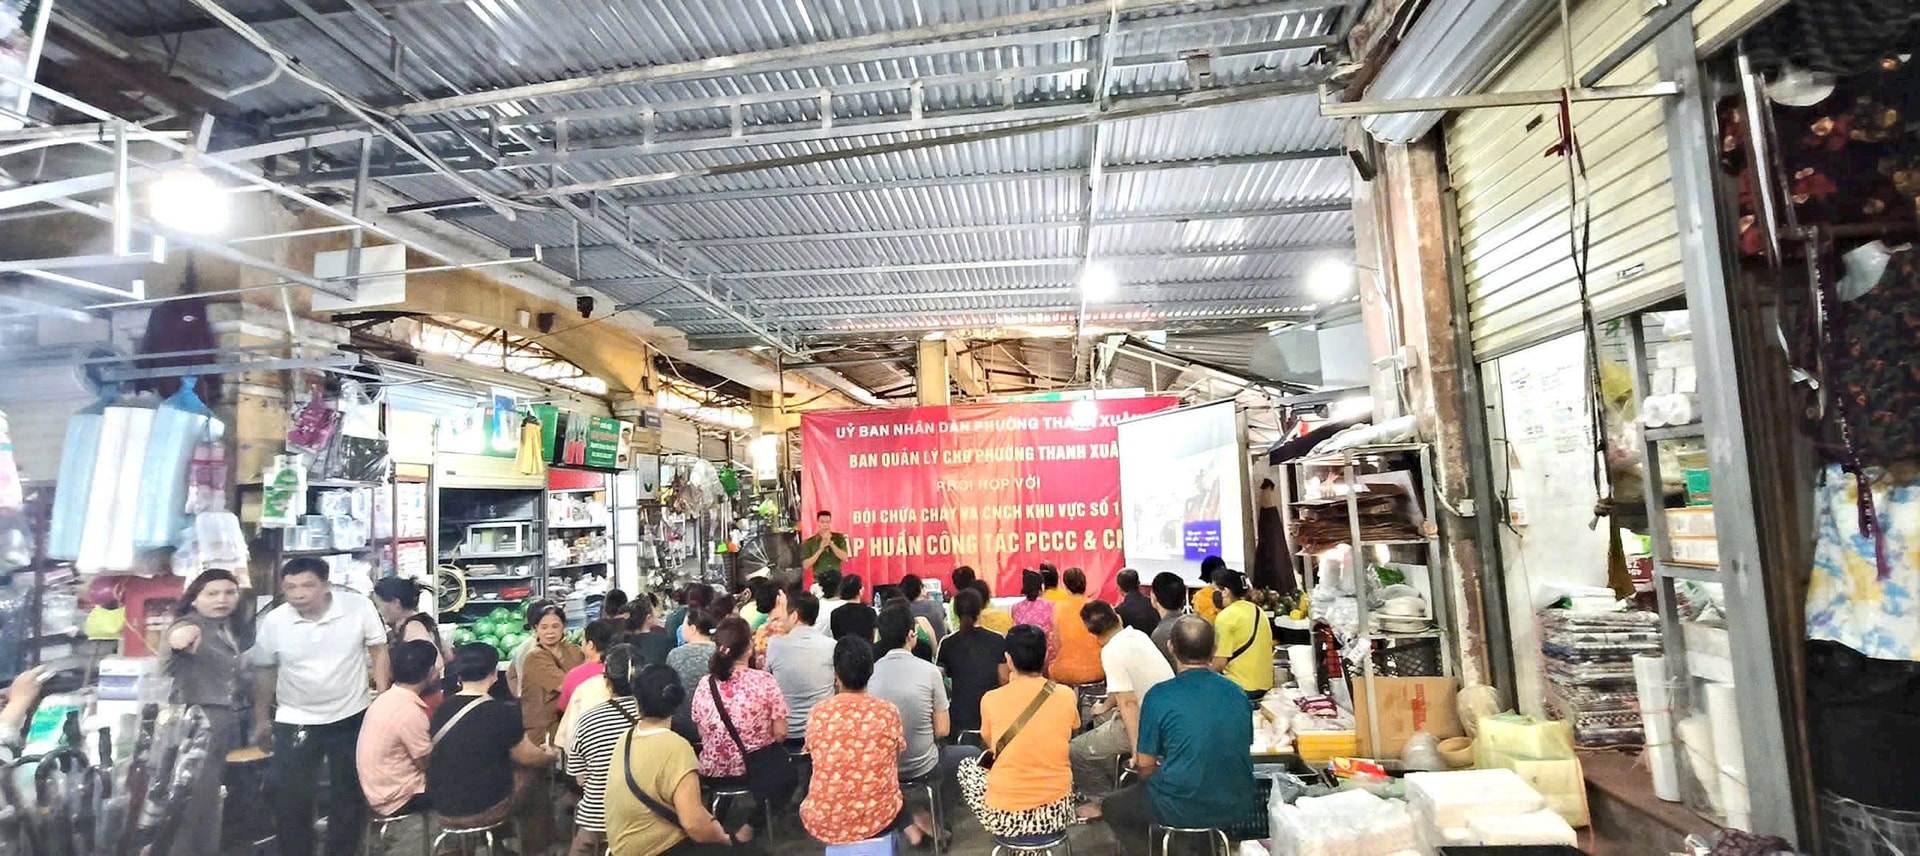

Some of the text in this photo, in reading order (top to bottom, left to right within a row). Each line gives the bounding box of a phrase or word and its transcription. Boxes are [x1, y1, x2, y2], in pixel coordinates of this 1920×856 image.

[859, 424, 889, 438] BAN
[893, 420, 935, 436] NHÂN
[1043, 415, 1096, 431] THA
[1100, 411, 1144, 428] XUÂ
[849, 453, 878, 468] BAN
[881, 448, 920, 468] QUẢN
[923, 449, 939, 465] LÝ
[1038, 444, 1087, 461] THANH
[1090, 441, 1119, 459] XUÂ
[982, 504, 1022, 520] CNCH
[1025, 503, 1054, 519] KHU
[1058, 501, 1086, 520] VỰC
[1089, 496, 1109, 517] SỐ
[843, 533, 865, 560] ẬP
[870, 529, 921, 558] HUẤN
[926, 530, 978, 556] CÔNG
[983, 528, 1020, 553] TÁC
[1025, 530, 1078, 553] PCCC
[1083, 529, 1098, 551] &
